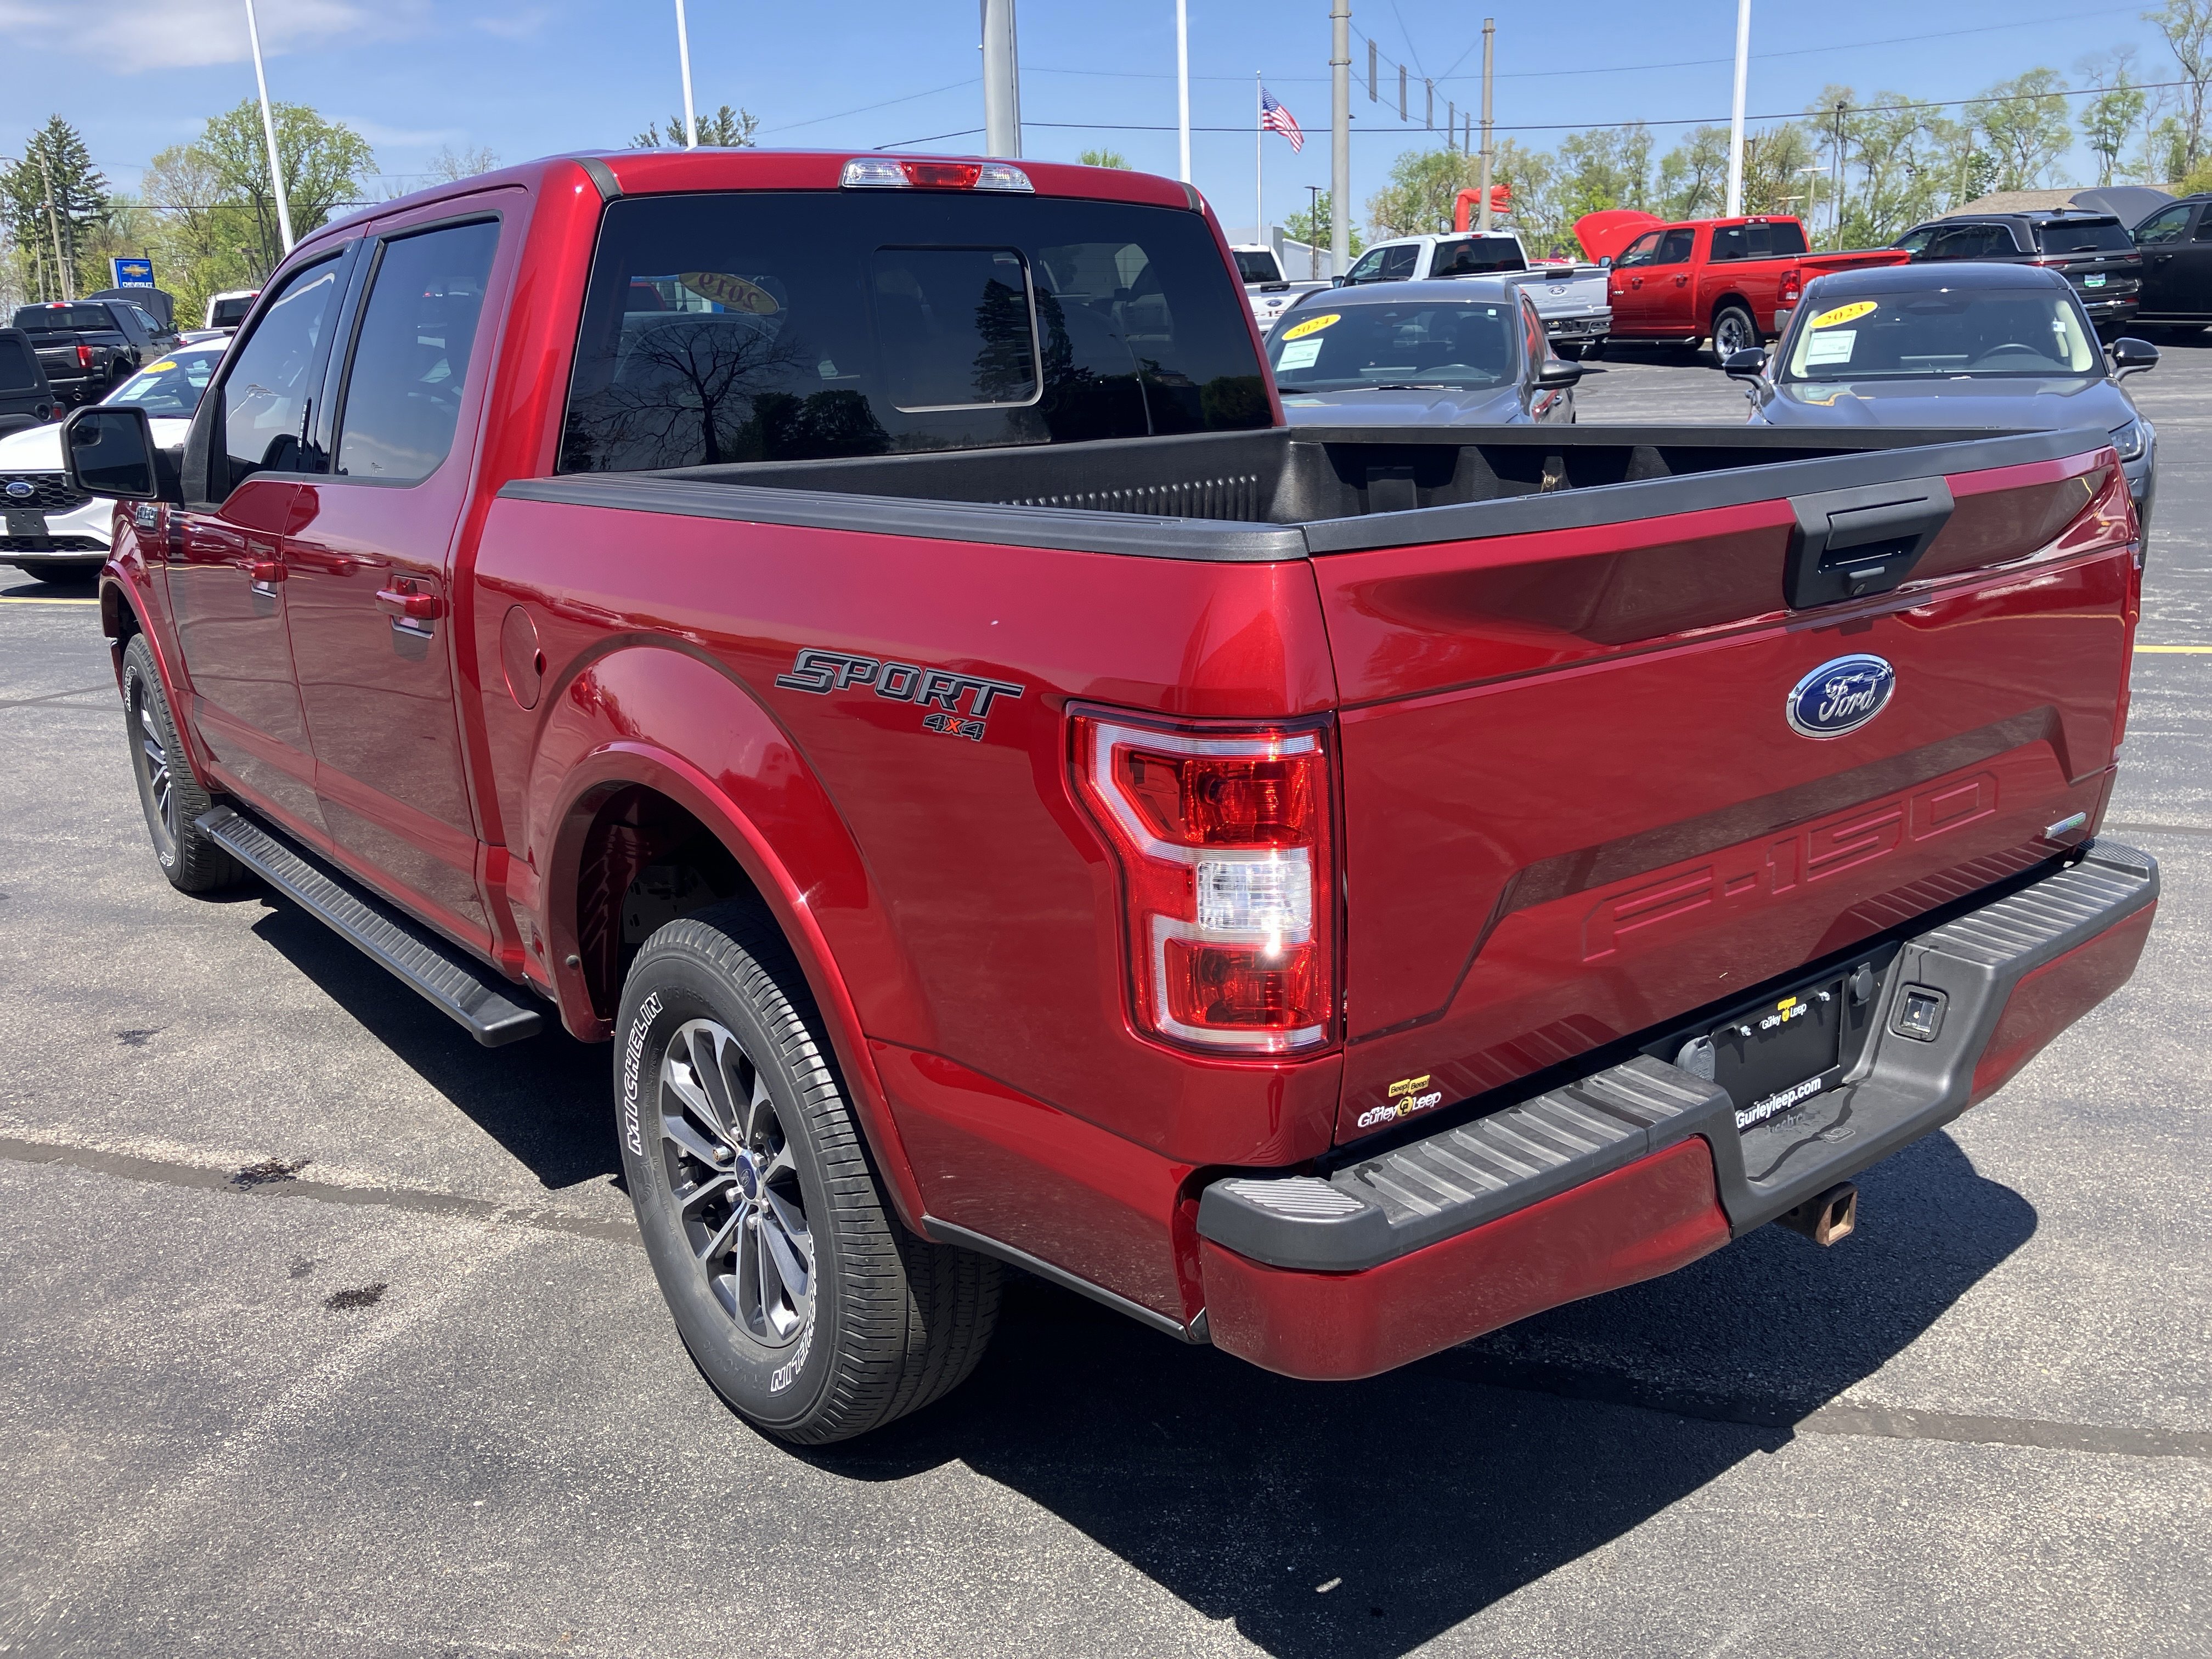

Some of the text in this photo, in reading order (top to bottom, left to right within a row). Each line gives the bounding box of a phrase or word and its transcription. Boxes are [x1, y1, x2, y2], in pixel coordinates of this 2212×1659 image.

[1294, 317, 1329, 337] 2024
[1824, 304, 1864, 325] 2023
[775, 647, 1025, 718] SPORT
[1818, 672, 1877, 721] Ford
[1582, 771, 1999, 961] F-150
[1762, 1015, 1781, 1030] Gurley
[1790, 1003, 1807, 1018] Leep
[623, 991, 663, 1156] MICHELIN
[1390, 1078, 1430, 1094] Beep! Beep!
[1357, 1104, 1398, 1128] Gurley
[1412, 1092, 1442, 1111] Leep
[1736, 1077, 1821, 1128] Gurleyleep.com
